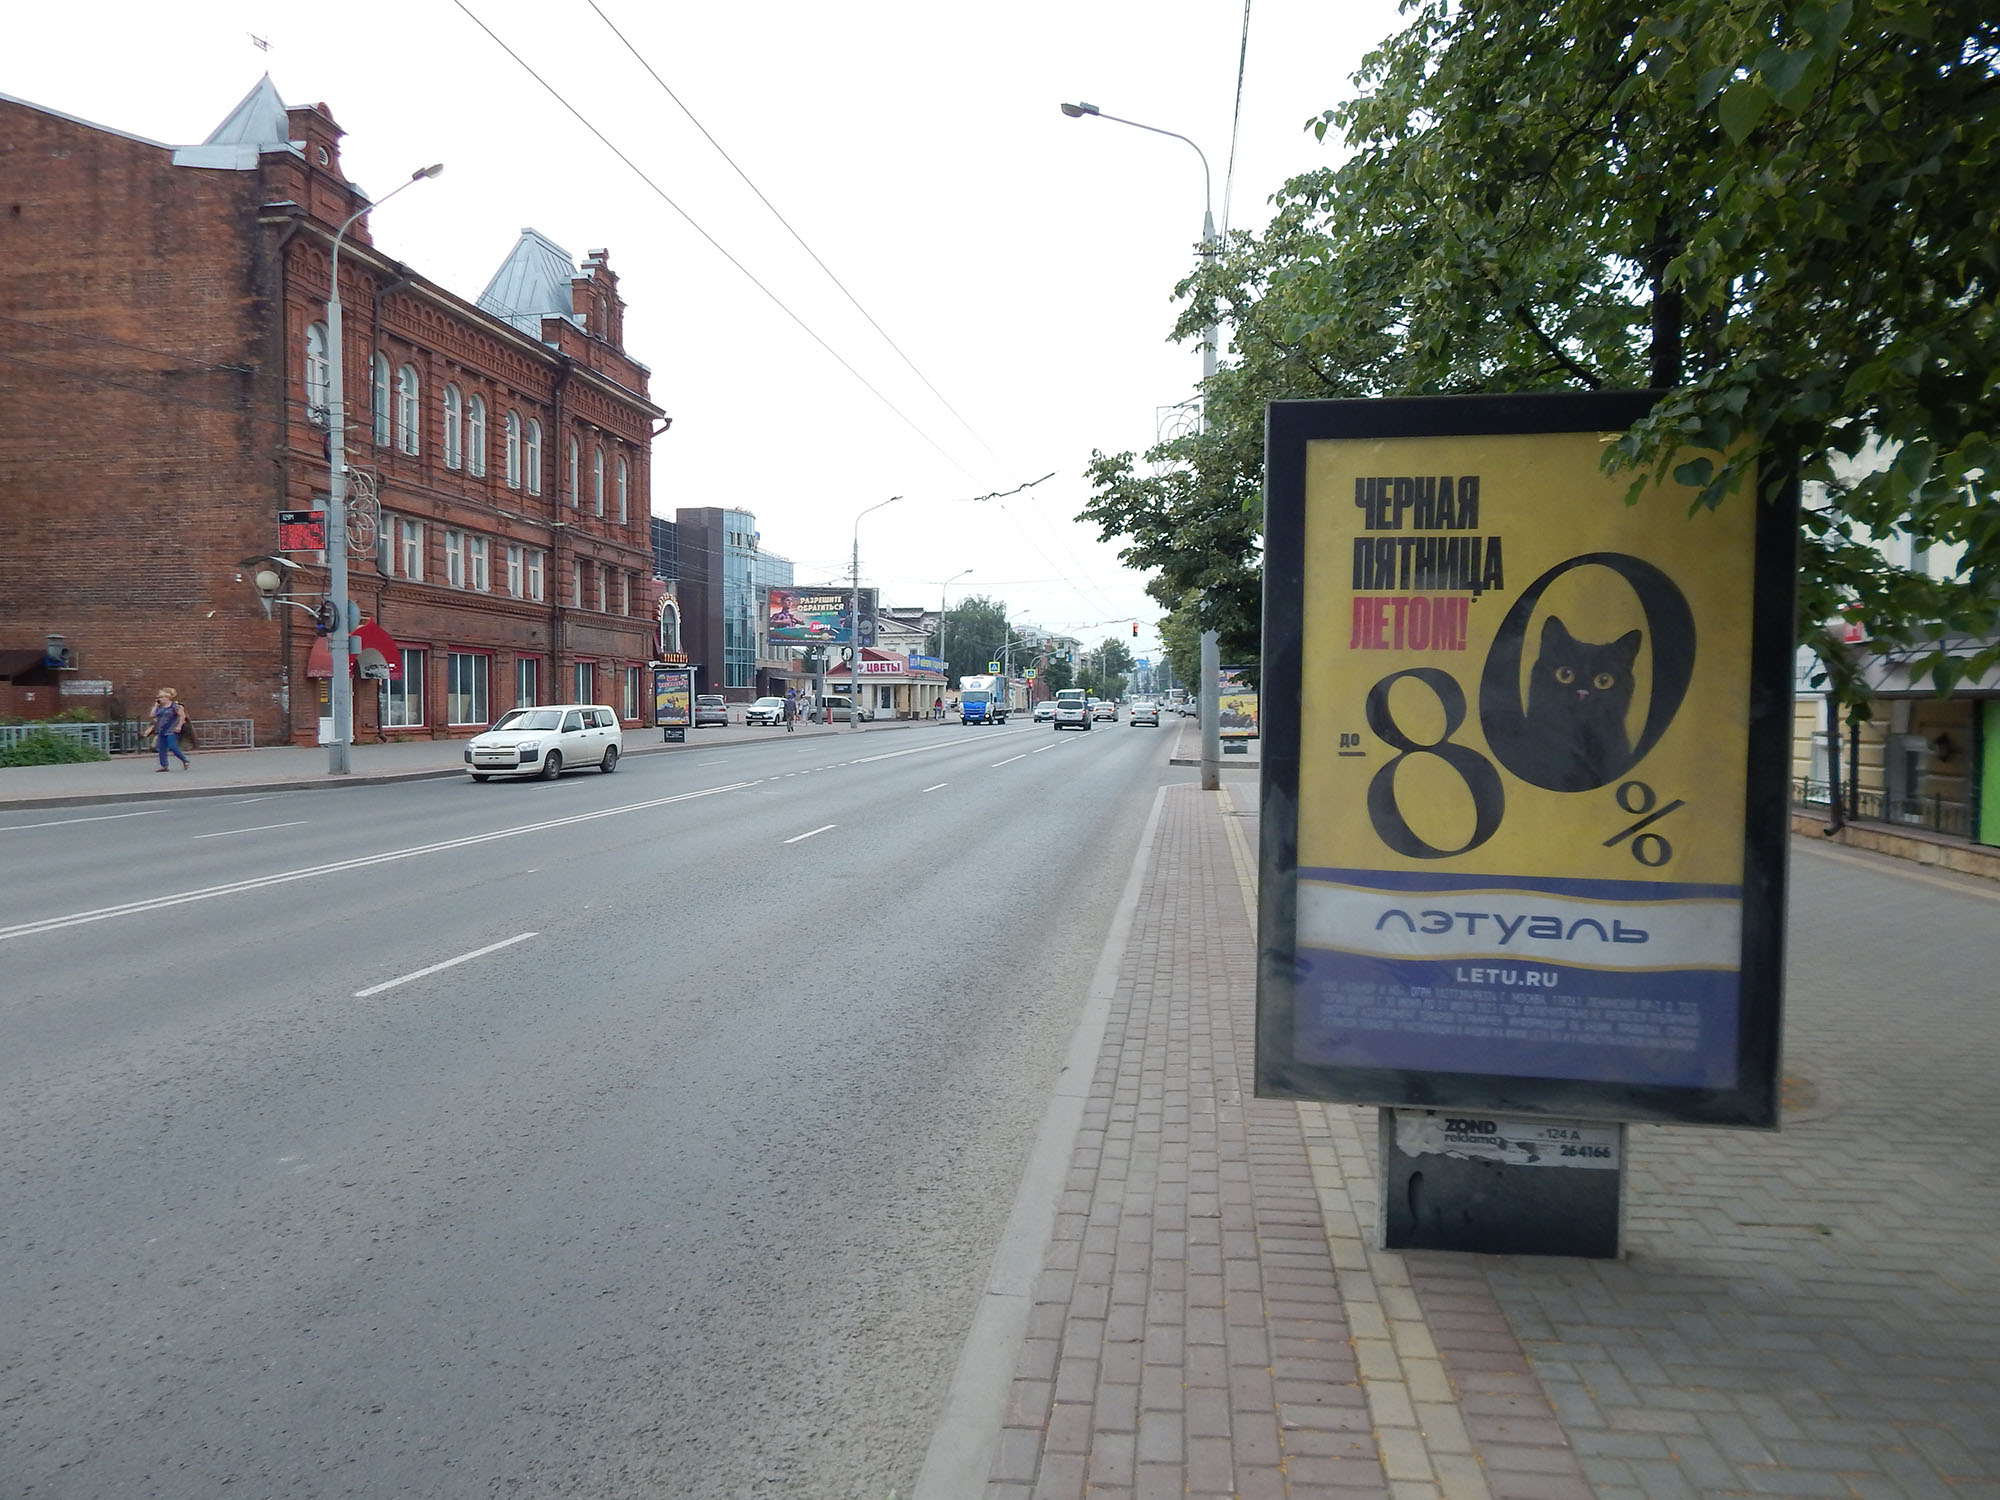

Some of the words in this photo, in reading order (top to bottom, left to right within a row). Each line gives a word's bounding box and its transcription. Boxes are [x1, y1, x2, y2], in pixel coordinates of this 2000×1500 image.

[1354, 475, 1480, 530] ЧЕРНАЯ
[1352, 536, 1504, 597] ПЯТНИЦА
[800, 596, 842, 604] РАЗРЕШИТЕ
[797, 603, 844, 612] ОБРАТИТЬСЯ
[866, 663, 900, 672] ЦВЕТЫ
[1456, 967, 1559, 988] LETU.RU
[1445, 1118, 1497, 1135] ZOND
[1444, 1133, 1497, 1146] reklama
[1546, 1128, 1567, 1139] 124
